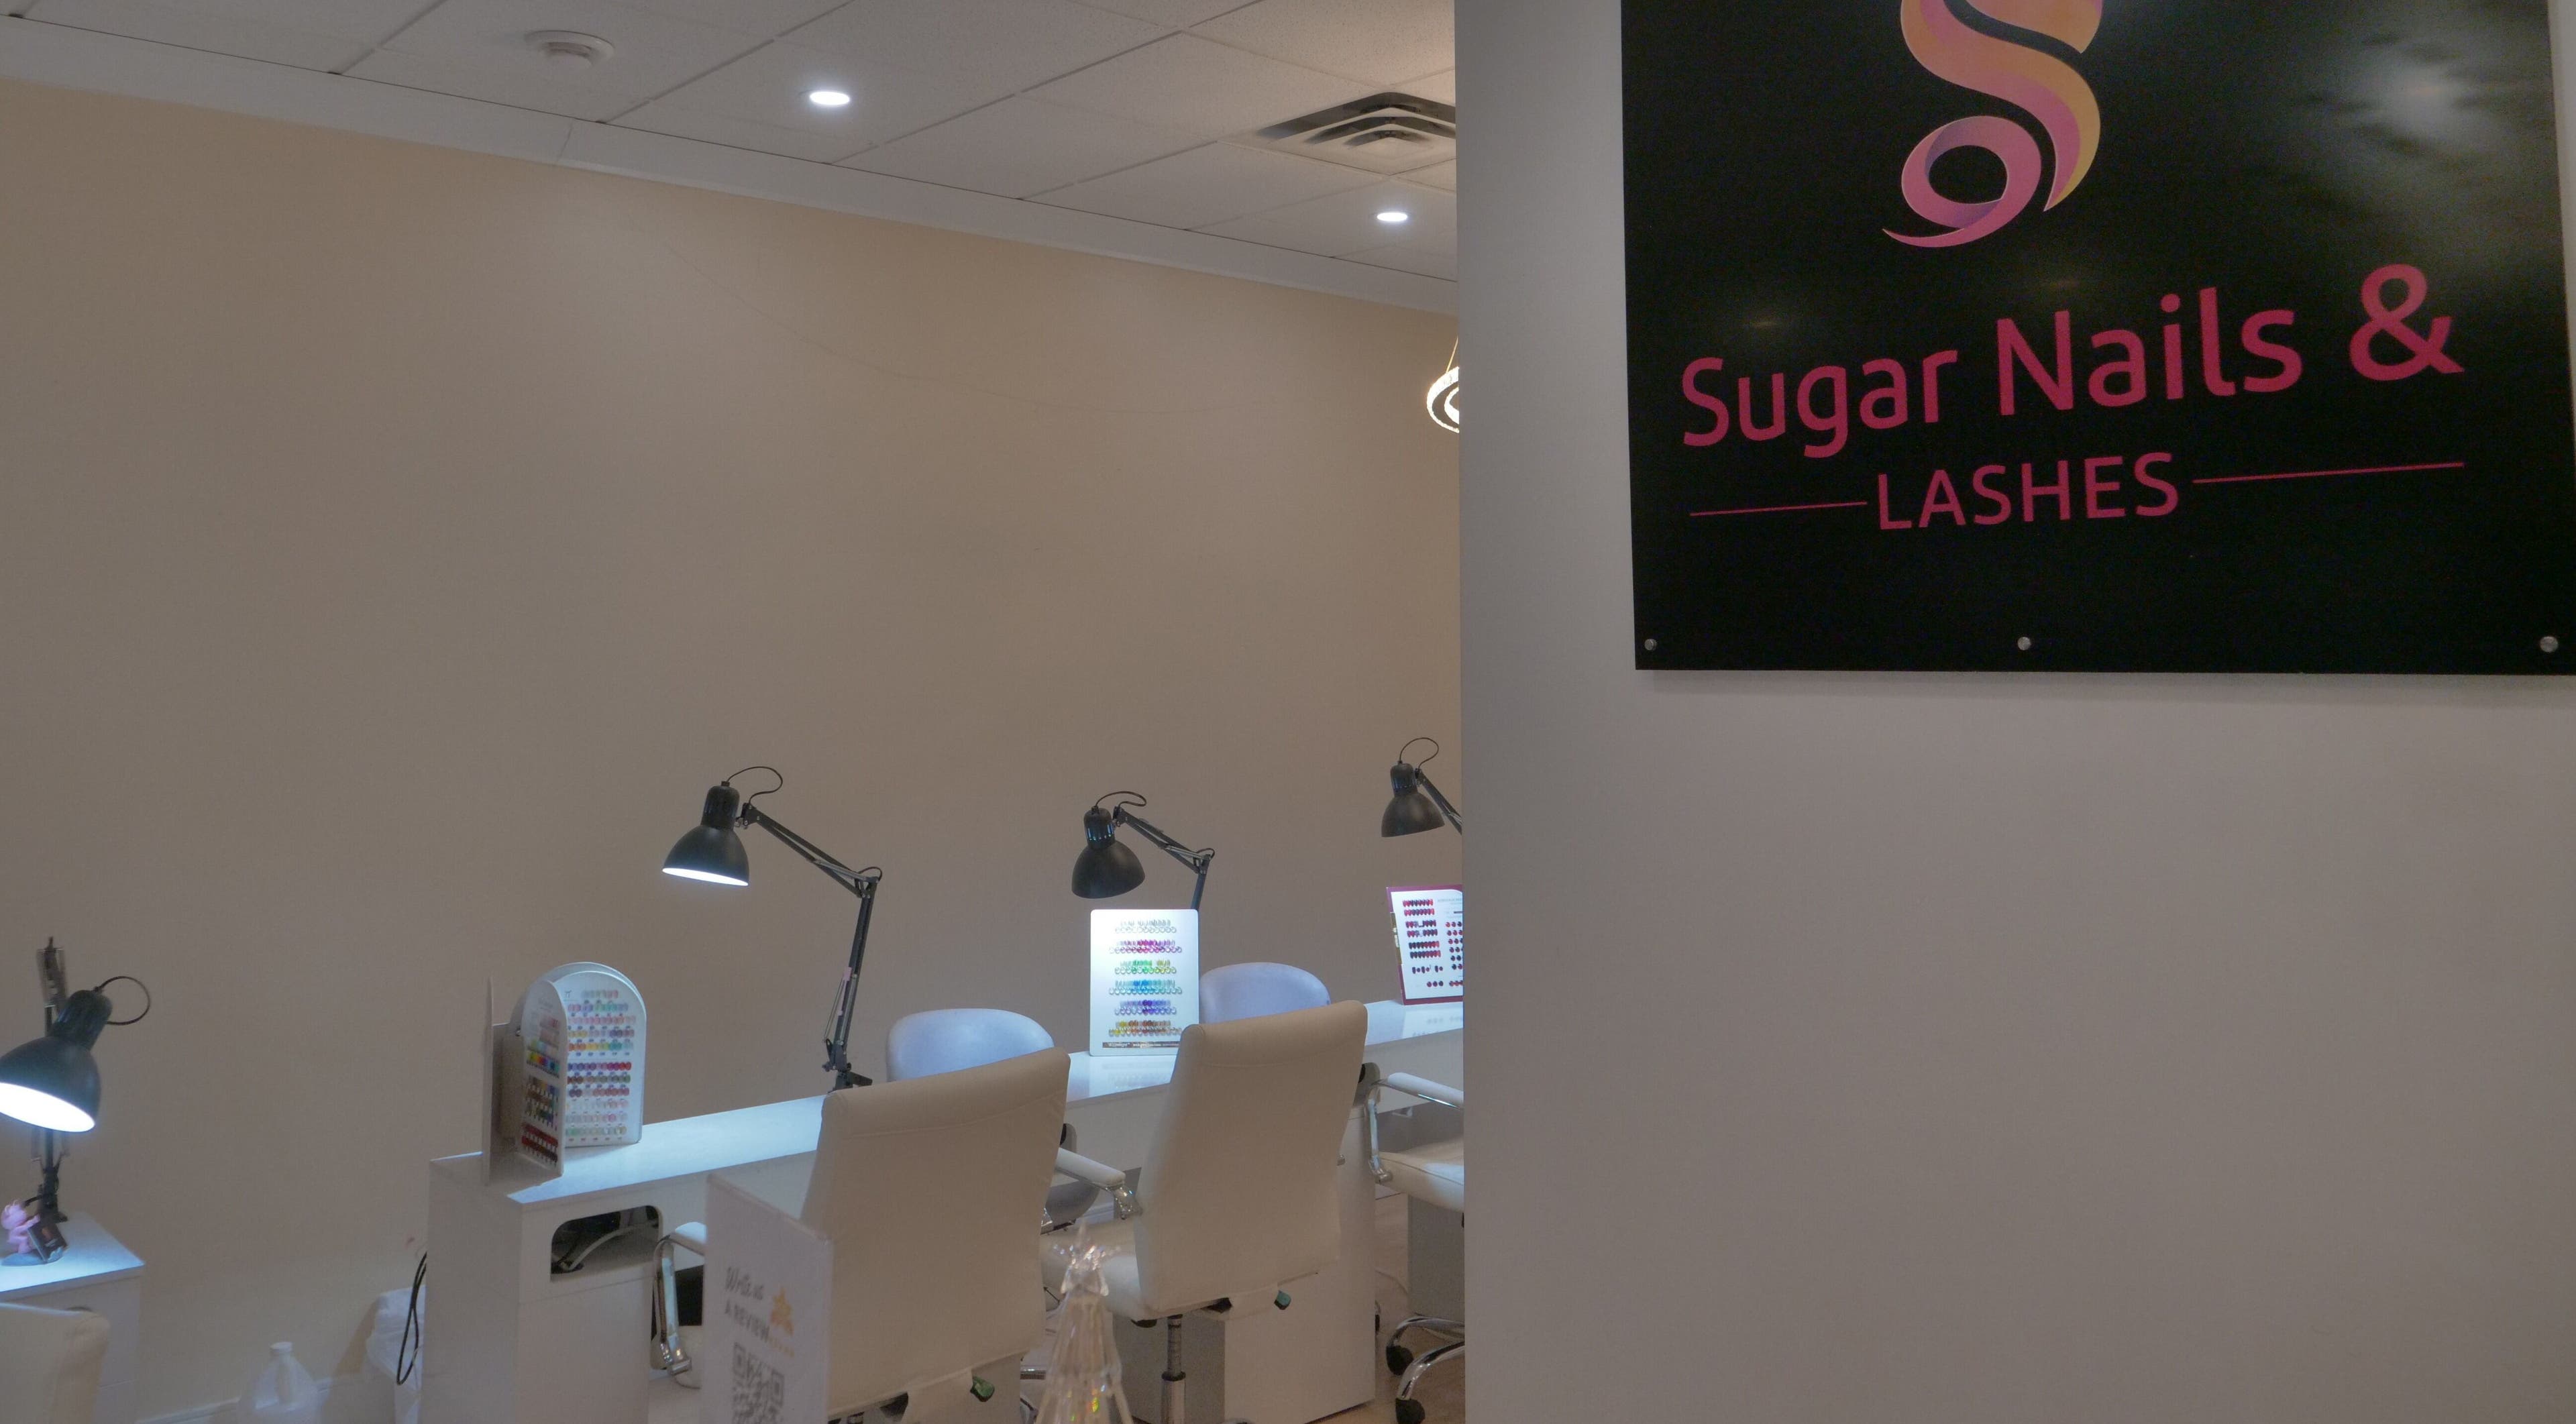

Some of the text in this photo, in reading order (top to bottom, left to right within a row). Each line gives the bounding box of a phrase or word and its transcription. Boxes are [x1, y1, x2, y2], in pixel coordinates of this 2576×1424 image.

[1682, 264, 2465, 459] Sugar Nails &
[1878, 451, 2180, 530] LASHES
